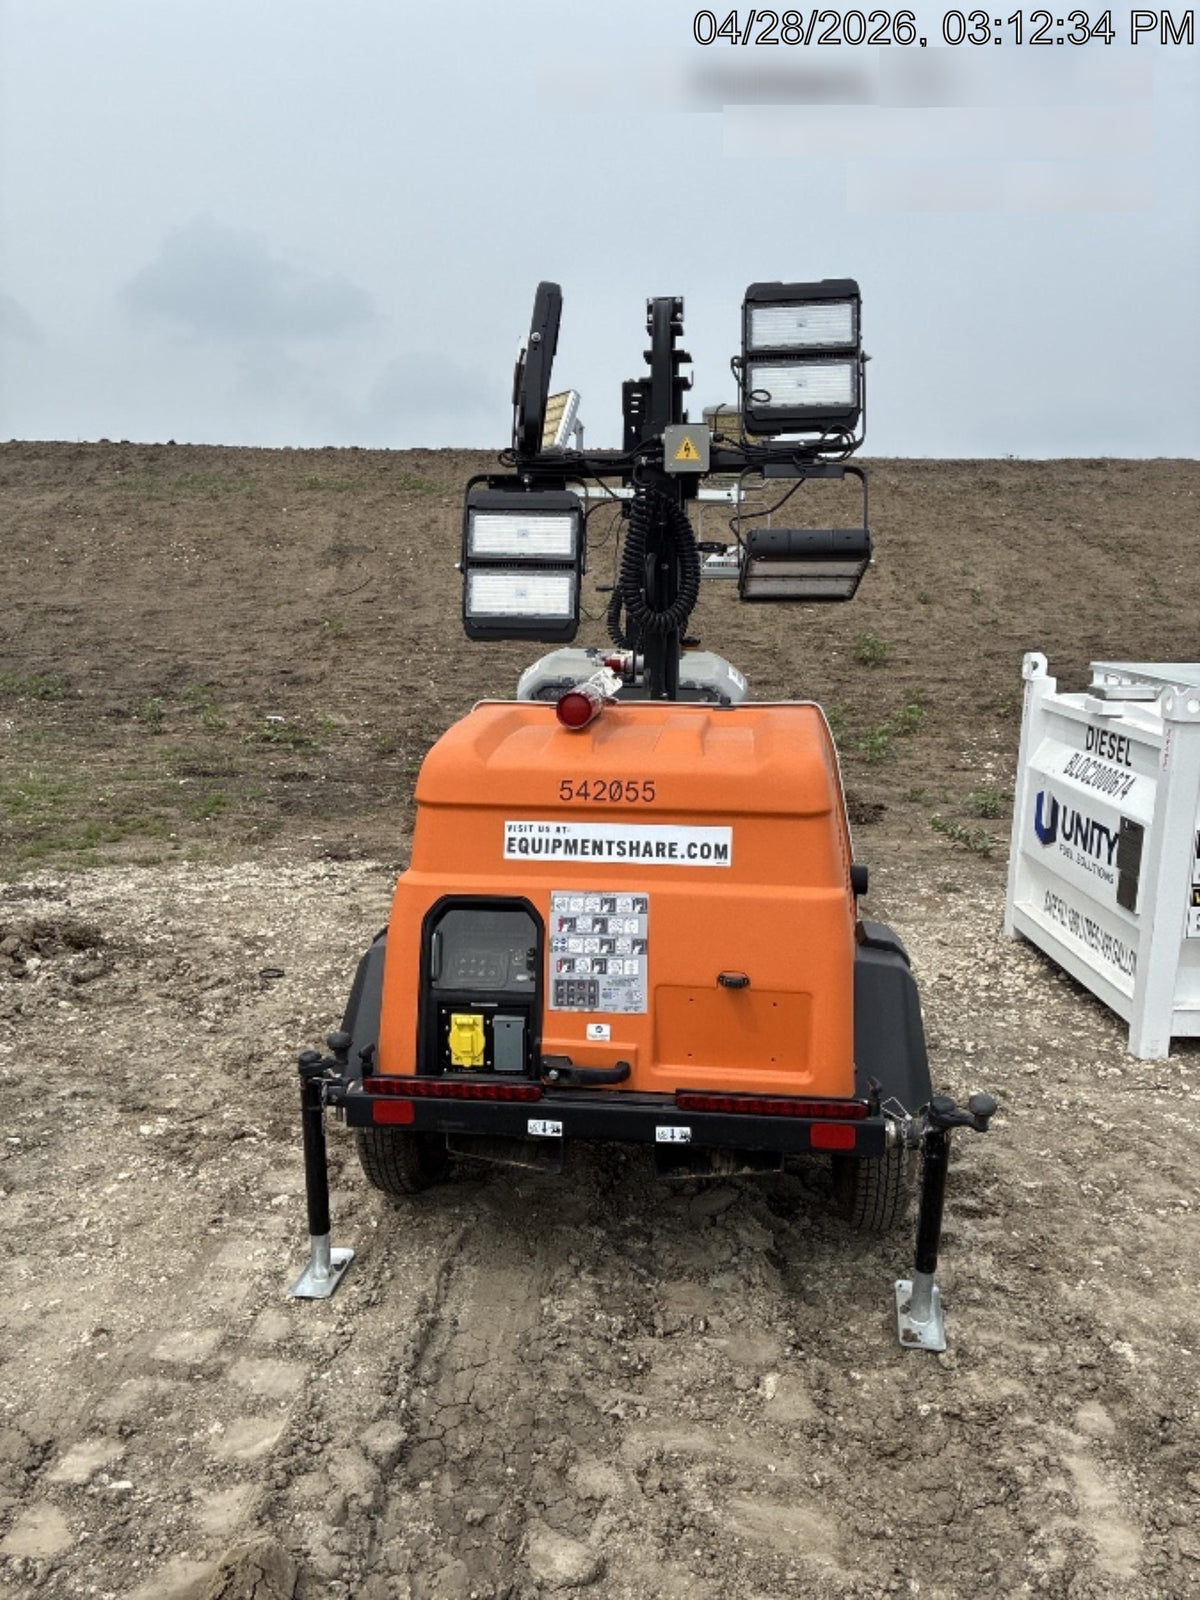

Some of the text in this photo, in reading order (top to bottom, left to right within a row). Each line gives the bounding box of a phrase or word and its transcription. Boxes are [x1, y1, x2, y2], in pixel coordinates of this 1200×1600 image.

[1086, 725, 1131, 767] DIESEL
[559, 780, 655, 802] 542055
[507, 824, 534, 833] VISIT
[538, 825, 551, 833] US
[1062, 805, 1119, 866] UNITY
[506, 837, 728, 860] EQUIPMENTSHARE.COM
